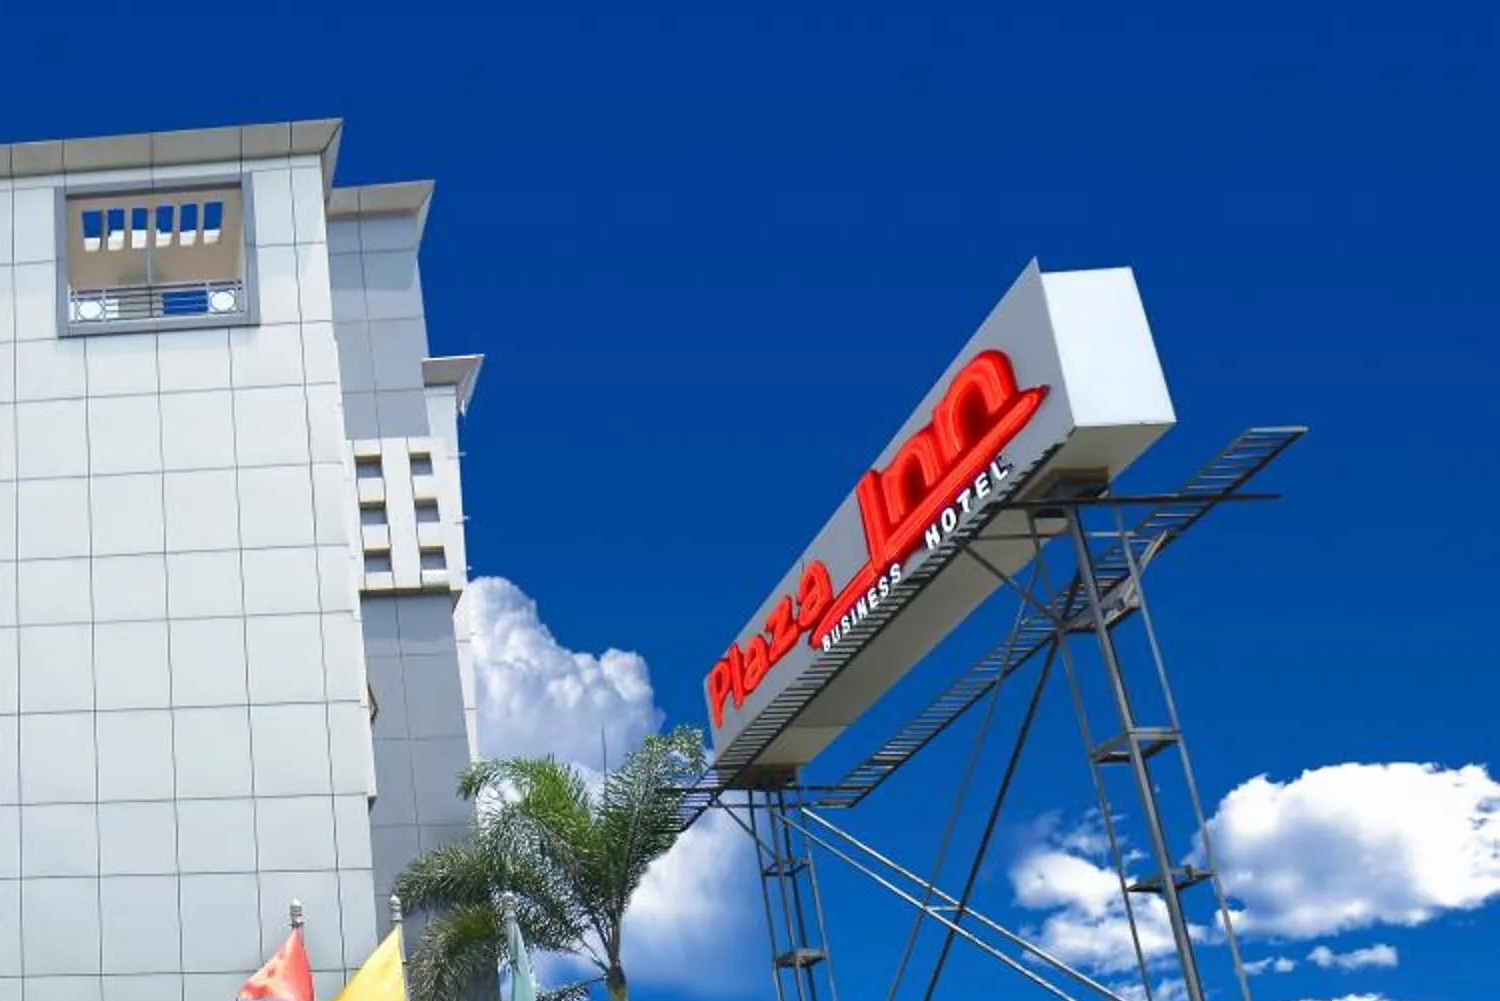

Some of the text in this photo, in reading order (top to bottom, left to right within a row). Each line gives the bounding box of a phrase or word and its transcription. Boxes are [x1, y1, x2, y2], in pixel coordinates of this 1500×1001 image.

[708, 348, 1020, 729] Plaza Inn
[821, 459, 1010, 652] BUSINESS HOTEL
